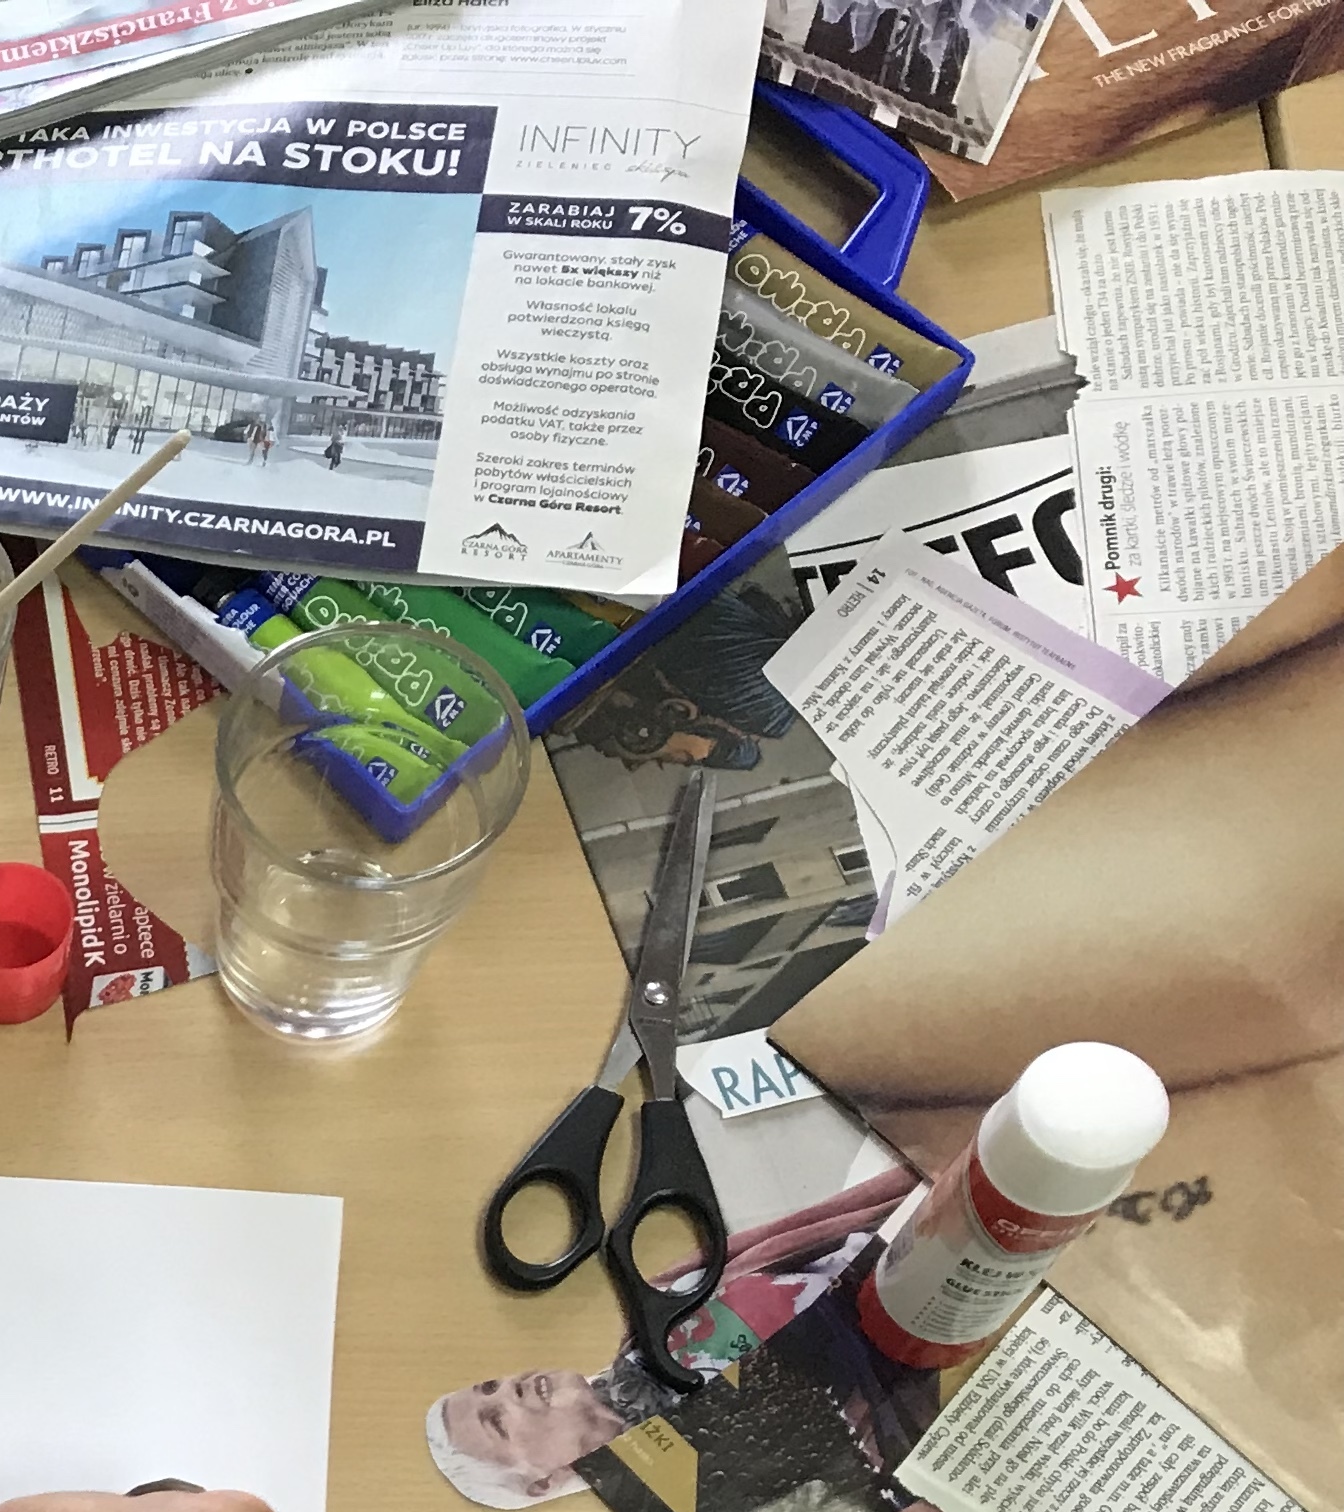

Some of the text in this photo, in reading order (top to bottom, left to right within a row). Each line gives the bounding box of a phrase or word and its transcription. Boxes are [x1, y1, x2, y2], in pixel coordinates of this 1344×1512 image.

[1091, 1, 1302, 89] THE NEW FRAGRANCE FOR
[103, 114, 291, 144] INWESTYCJA
[305, 118, 337, 136] W
[348, 119, 465, 141] POLSCE
[519, 115, 701, 166] INFINITY
[200, 141, 266, 166] NA
[282, 143, 461, 176] STOKU!
[507, 214, 613, 231] W SKALI ROKU
[509, 197, 615, 222] ZARABIAJ
[626, 204, 688, 235] 7%
[513, 261, 638, 280] nawet większy
[609, 254, 676, 271] stały zysk
[536, 273, 583, 288] lokacie
[475, 451, 634, 474] Szeroki zakres terminów
[487, 493, 572, 510] Czarna Góra
[1111, 421, 1140, 550] kartki, śledzie wódkę
[1093, 465, 1123, 570] Pomnik drugi:
[43, 744, 64, 803] RETRO 11
[67, 839, 105, 966] Monolipid K
[104, 882, 129, 940] zielarni
[131, 906, 155, 959] aptece
